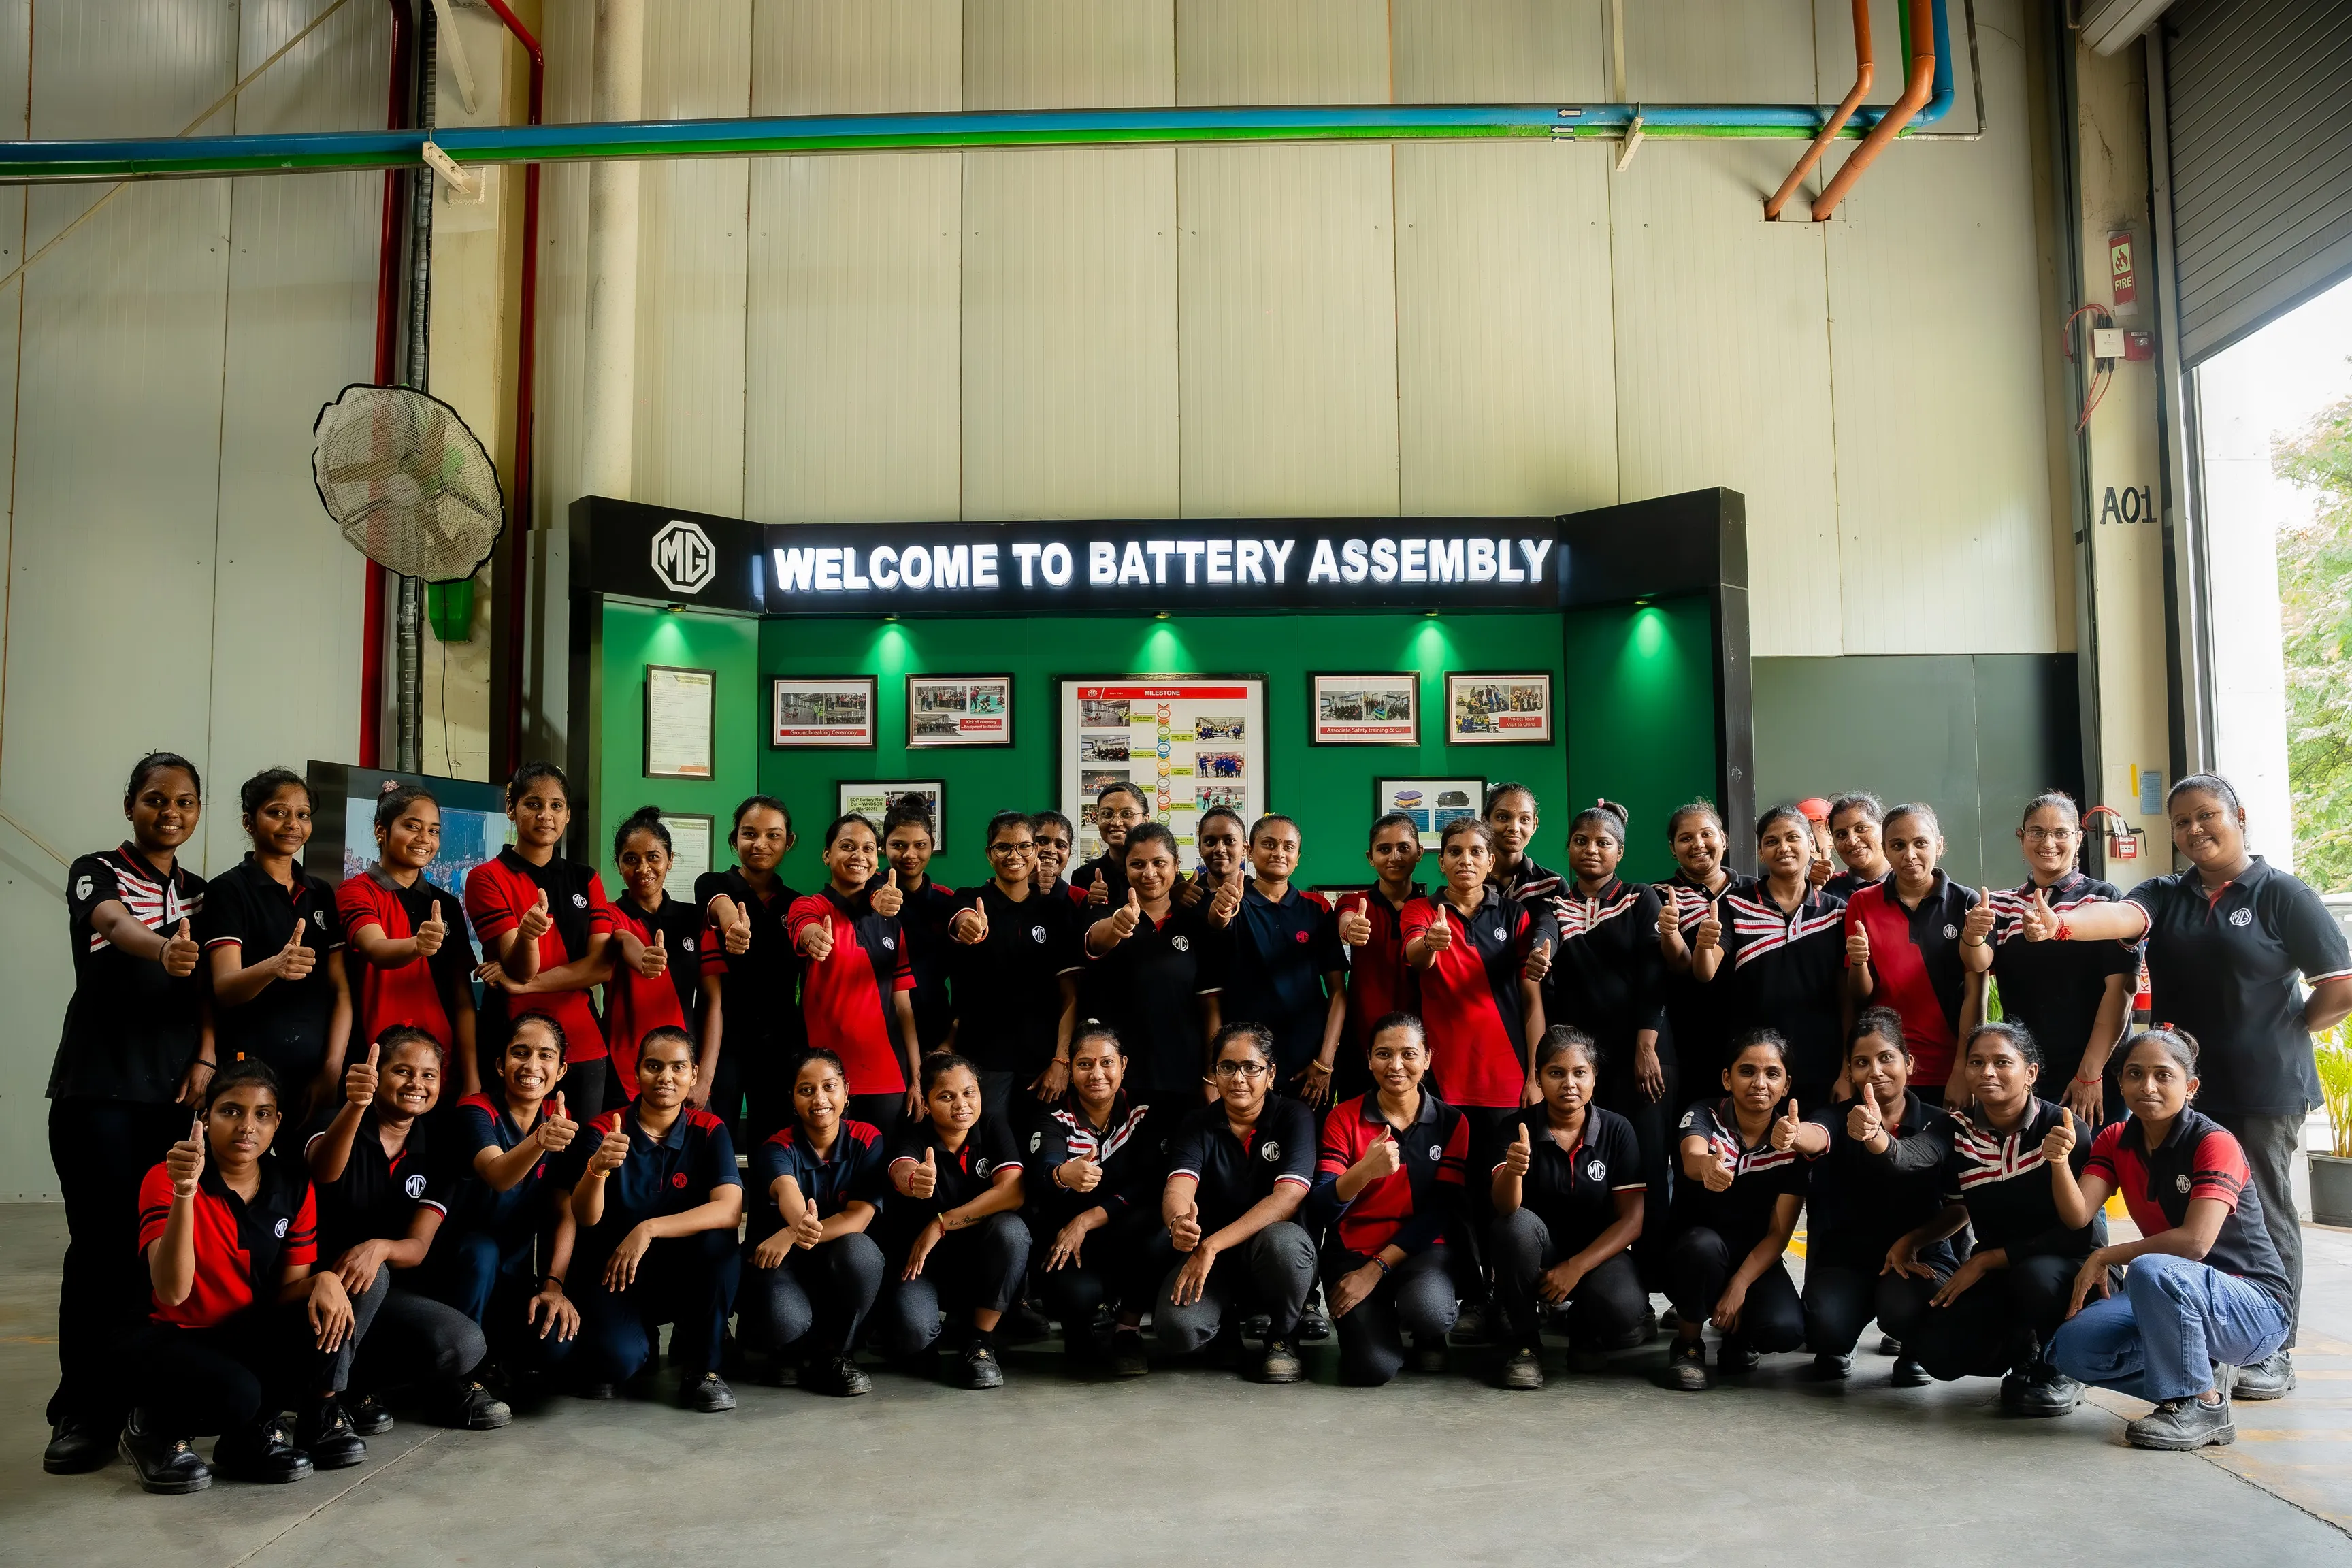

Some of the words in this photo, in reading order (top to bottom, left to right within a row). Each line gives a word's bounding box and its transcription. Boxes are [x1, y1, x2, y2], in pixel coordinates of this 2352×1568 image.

[2114, 276, 2132, 291] FIRE
[2100, 485, 2158, 525] A01
[656, 525, 711, 589] MG
[773, 545, 998, 591] WELCOME
[1012, 542, 1073, 588] TO
[1089, 540, 1295, 585] BATTERY
[1307, 538, 1553, 583] ASSEMBLY
[76, 876, 93, 900] 6
[574, 895, 586, 907] MG
[2231, 908, 2251, 924] MG
[1033, 927, 1045, 942] MG
[1297, 932, 1308, 942] MG
[1495, 928, 1506, 940] MG
[1944, 925, 1956, 938] MG
[684, 938, 693, 950] MG
[883, 937, 893, 949] MG
[1173, 936, 1188, 950] MG
[1679, 1112, 1694, 1128] 6
[1030, 1132, 1041, 1153] 6
[1263, 1143, 1279, 1160] MG
[1431, 1146, 1441, 1160] MG
[1589, 1162, 1604, 1179] MG
[407, 1176, 425, 1196] MG
[673, 1174, 686, 1187] MG
[2177, 1176, 2190, 1192] MG
[276, 1219, 287, 1237] MG
